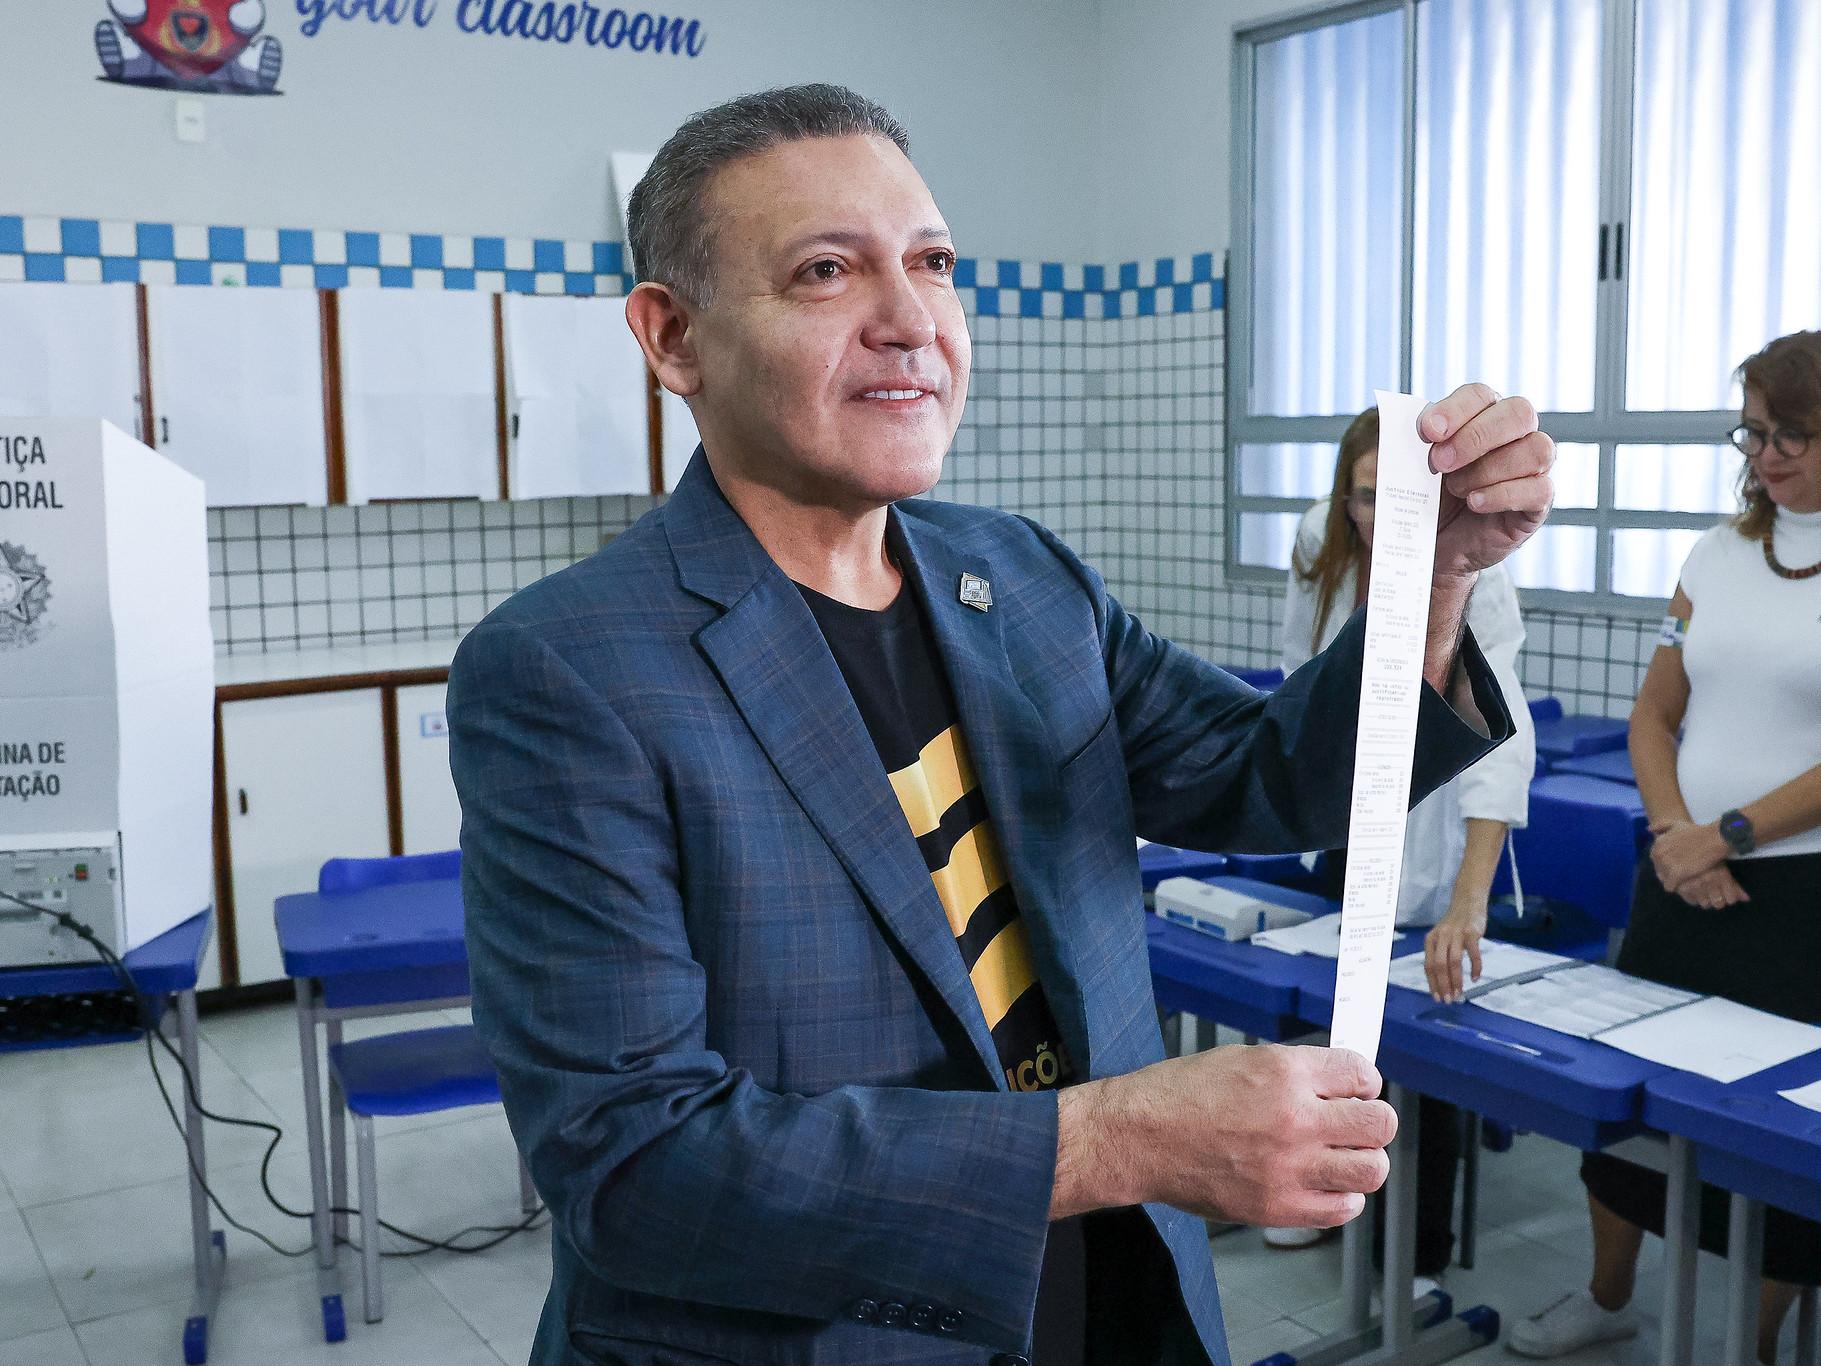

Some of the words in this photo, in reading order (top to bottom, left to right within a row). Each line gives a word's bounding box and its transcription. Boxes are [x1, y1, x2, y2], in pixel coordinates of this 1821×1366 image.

[456, 0, 706, 57] classroom
[0, 480, 64, 509] ORAL
[39, 742, 66, 764] DE
